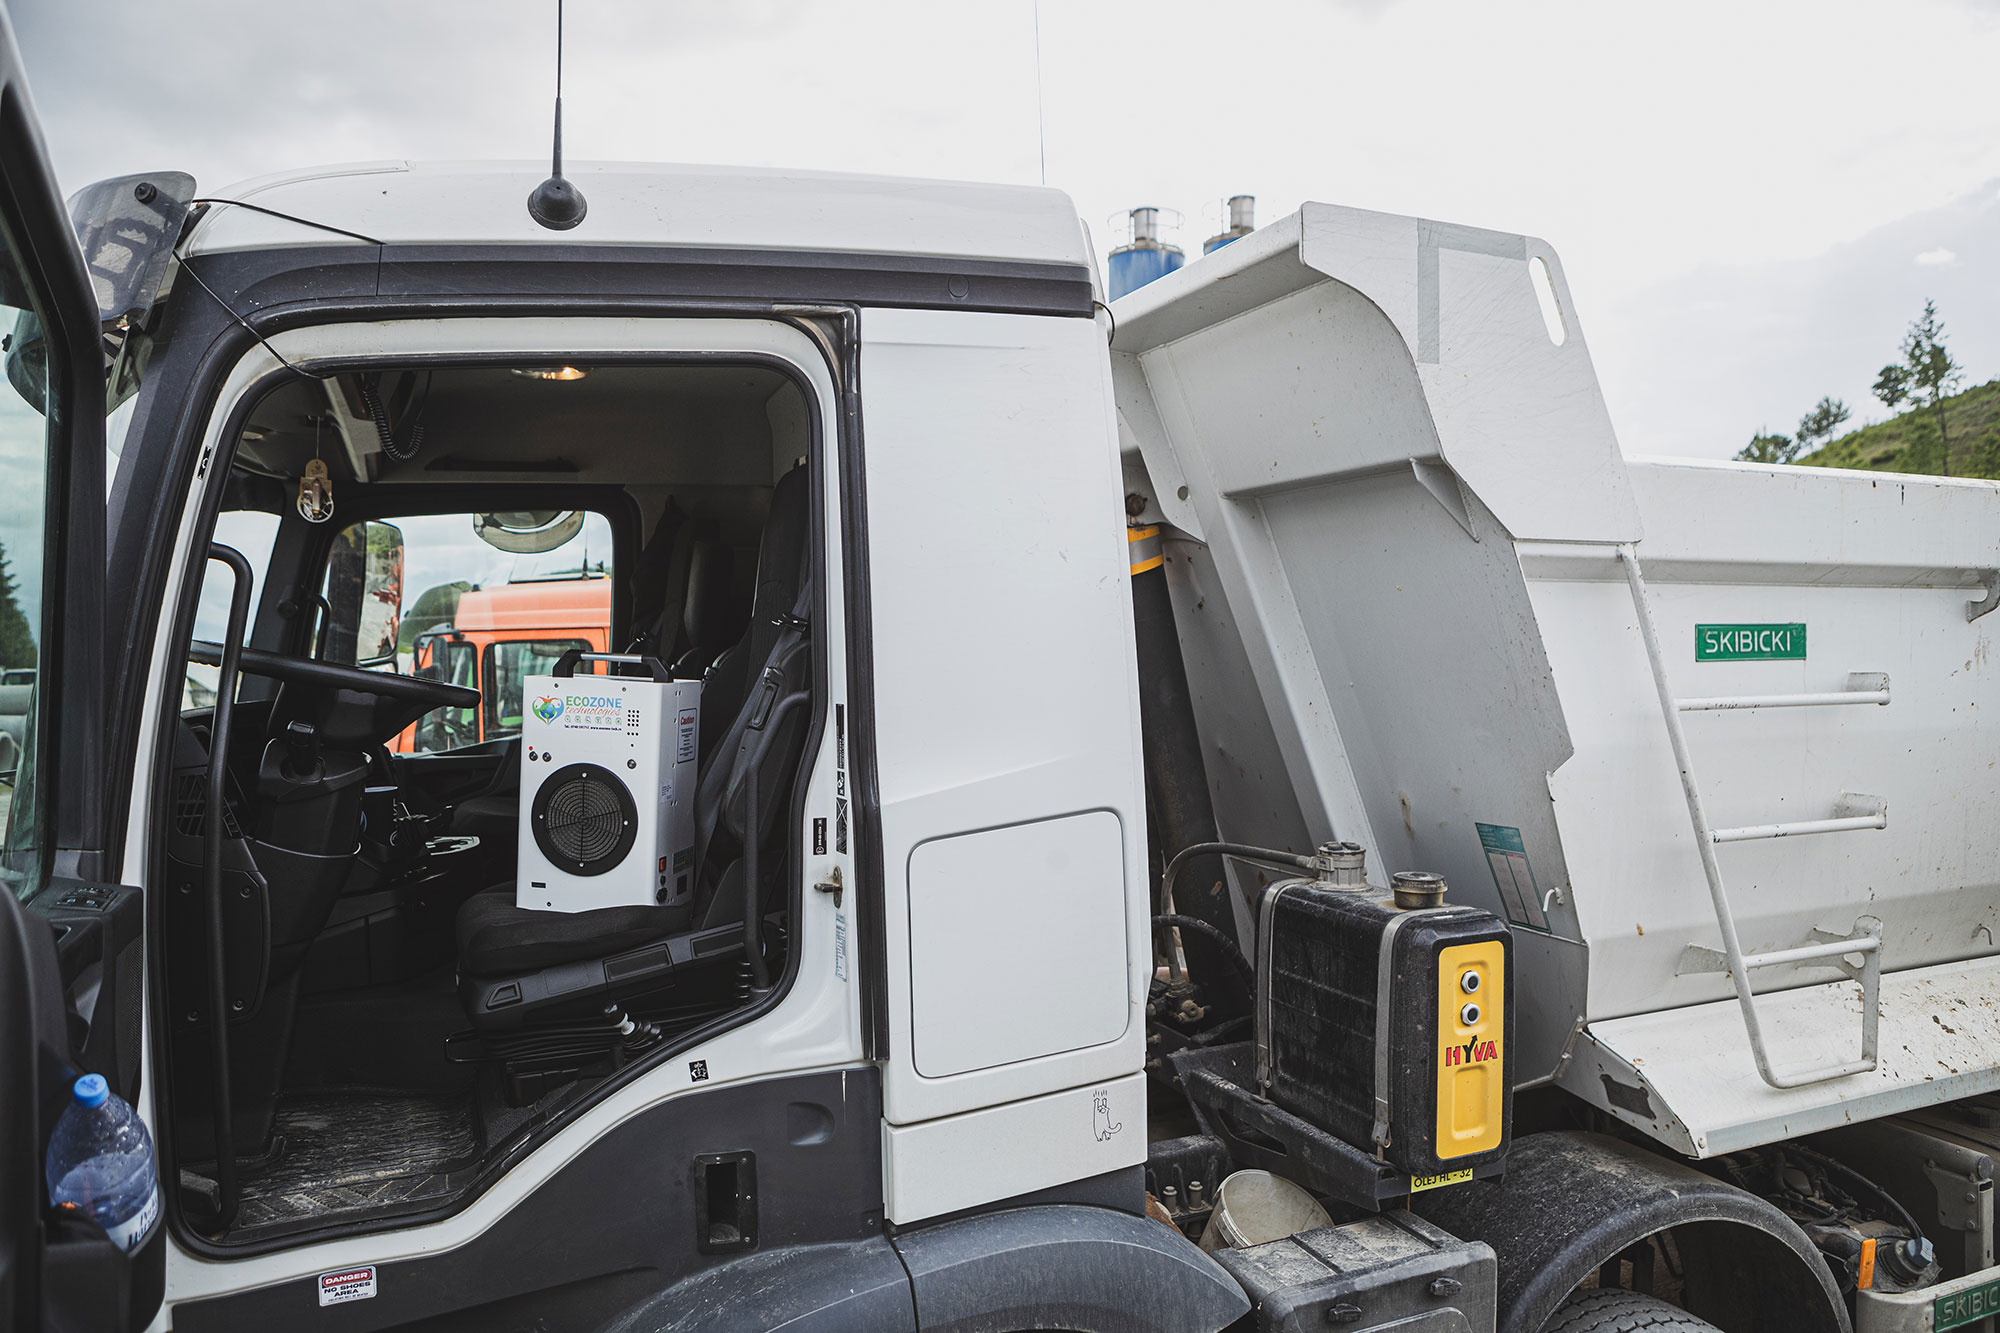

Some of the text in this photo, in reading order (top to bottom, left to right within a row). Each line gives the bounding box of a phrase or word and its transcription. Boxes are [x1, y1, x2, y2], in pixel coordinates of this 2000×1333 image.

[1705, 630, 1791, 653] SKIBICKI
[565, 695, 622, 709] ECOZONE
[565, 705, 621, 718] technologies
[1445, 1035, 1498, 1067] HYVA
[1414, 1175, 1437, 1188] OLEJ
[1460, 1169, 1471, 1178] 32
[325, 1271, 369, 1285] DANGER
[324, 1281, 371, 1294] NO SHOES
[334, 1288, 359, 1298] AREA
